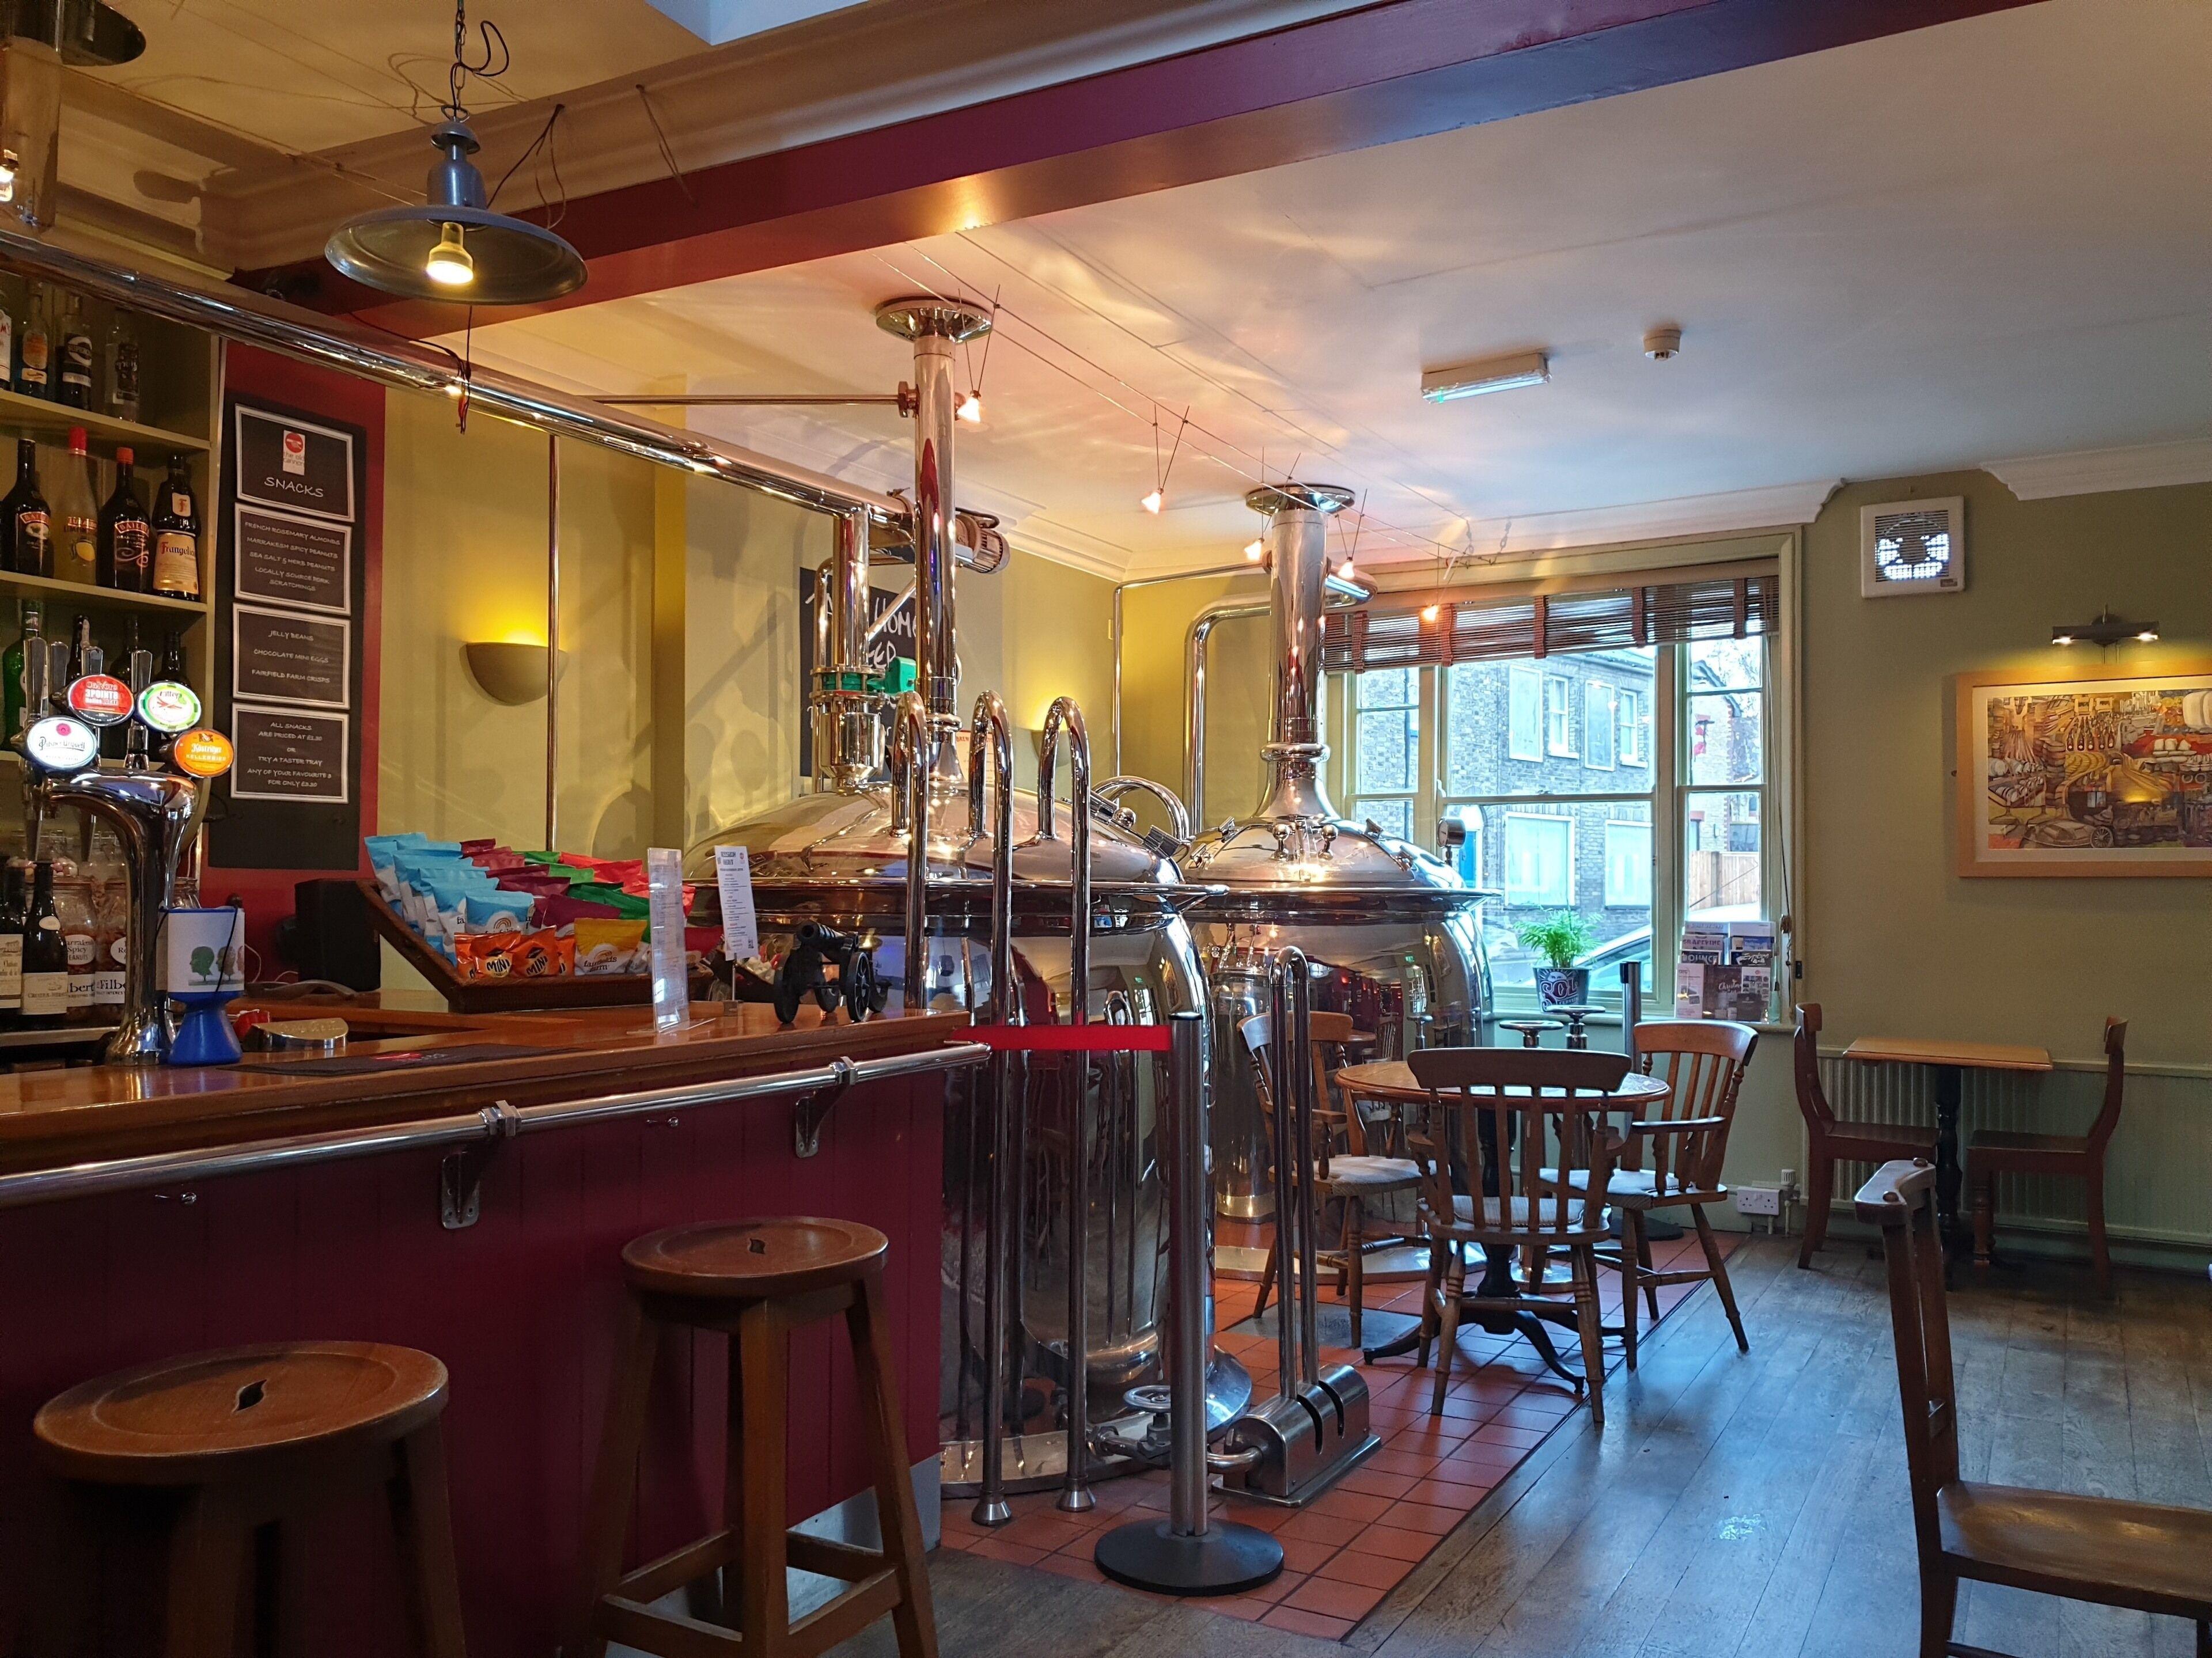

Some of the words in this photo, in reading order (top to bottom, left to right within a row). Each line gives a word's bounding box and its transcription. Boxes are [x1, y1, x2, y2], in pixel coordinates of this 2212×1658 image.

[264, 477, 324, 498] SNACKS
[245, 522, 270, 531] FRENCH
[272, 528, 309, 540] ROSEMARY
[309, 535, 340, 545] ALMONDS
[247, 537, 289, 548] MARRAKESH
[290, 545, 308, 553] SPICY
[309, 548, 338, 559] PEANUTS
[255, 567, 284, 578] LOCALLY
[307, 562, 335, 572] PEANUTS
[269, 579, 316, 591] SCRATCHINGS
[268, 631, 289, 639] JELLY
[291, 633, 313, 641] BEANS
[254, 649, 294, 659] CHOCOLATE
[252, 669, 285, 678] FAIRFIELD
[486, 958, 510, 972] MINI
[526, 956, 548, 975] MINI
[1540, 977, 1577, 1012] SOL
